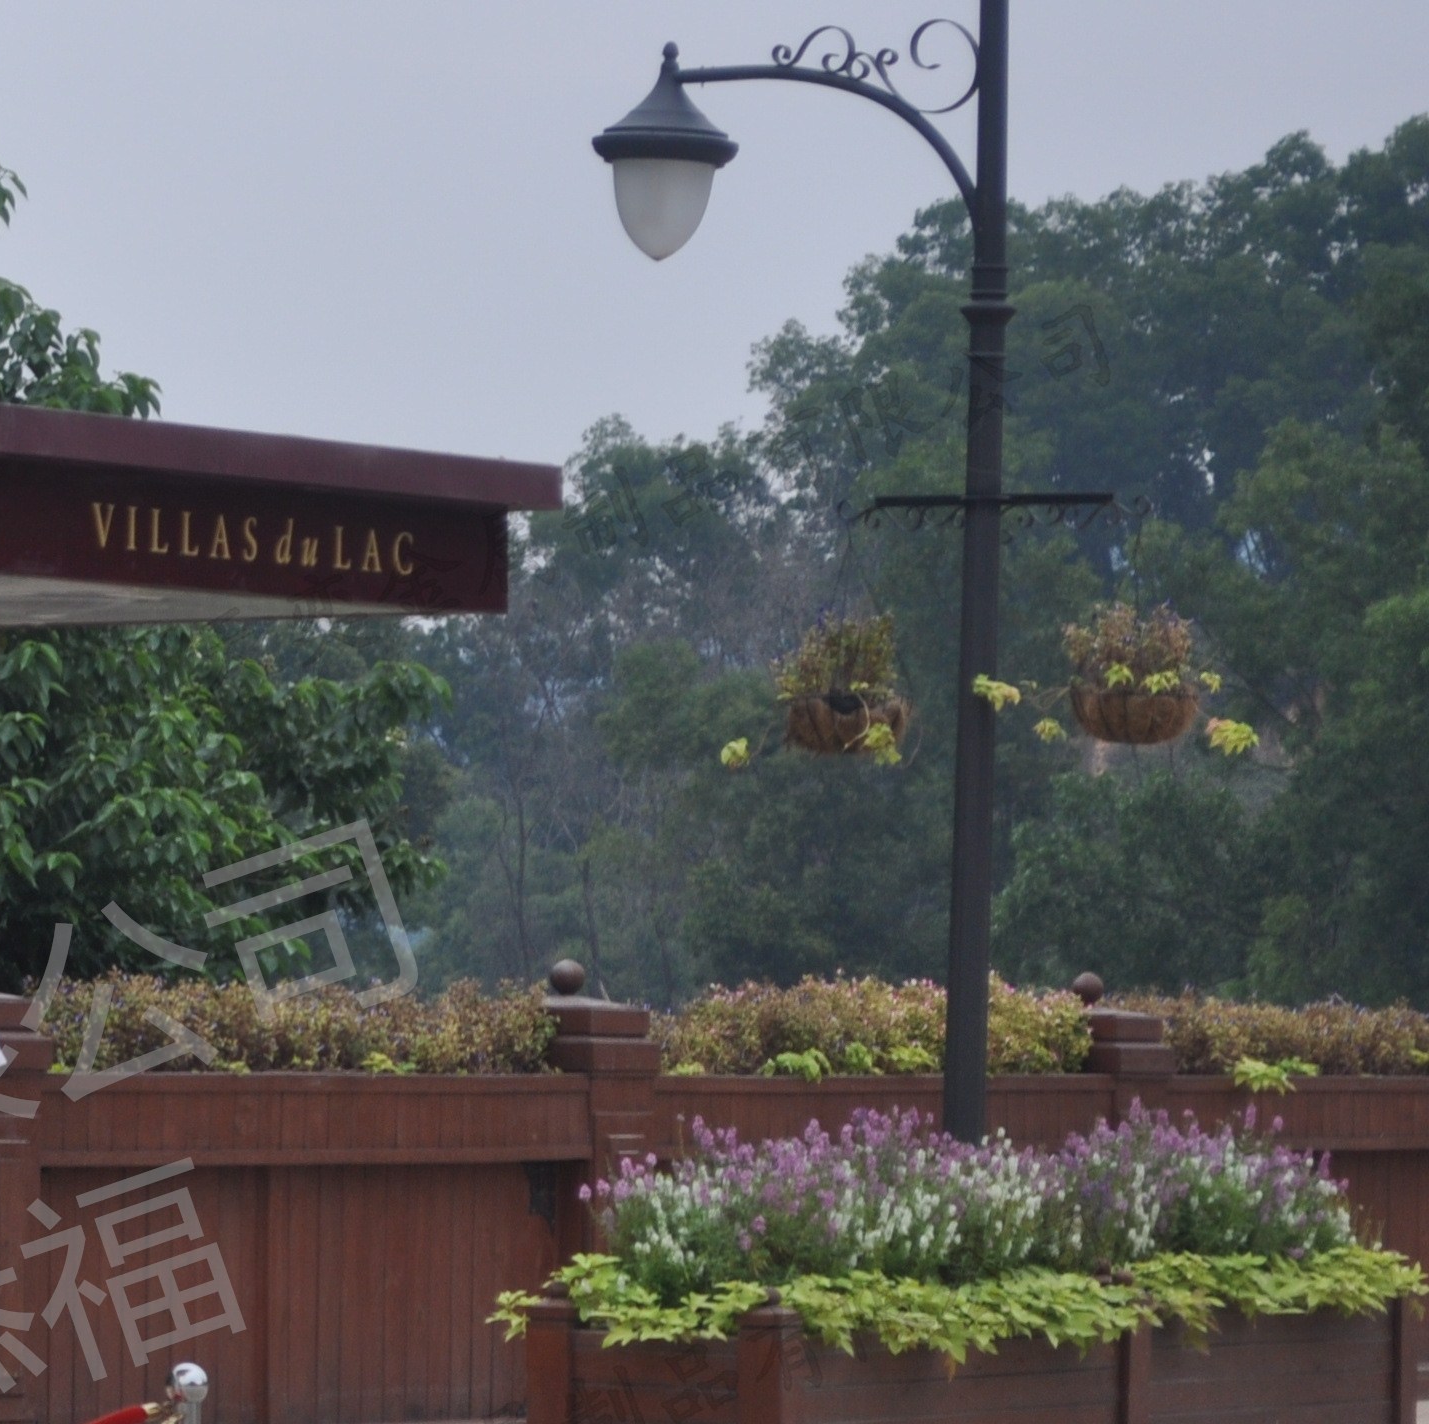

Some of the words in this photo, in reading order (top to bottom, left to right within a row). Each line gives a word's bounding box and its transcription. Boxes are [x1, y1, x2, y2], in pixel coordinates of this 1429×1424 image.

[91, 502, 260, 563] VILLAS
[274, 517, 320, 567] du
[334, 525, 415, 576] LAC
